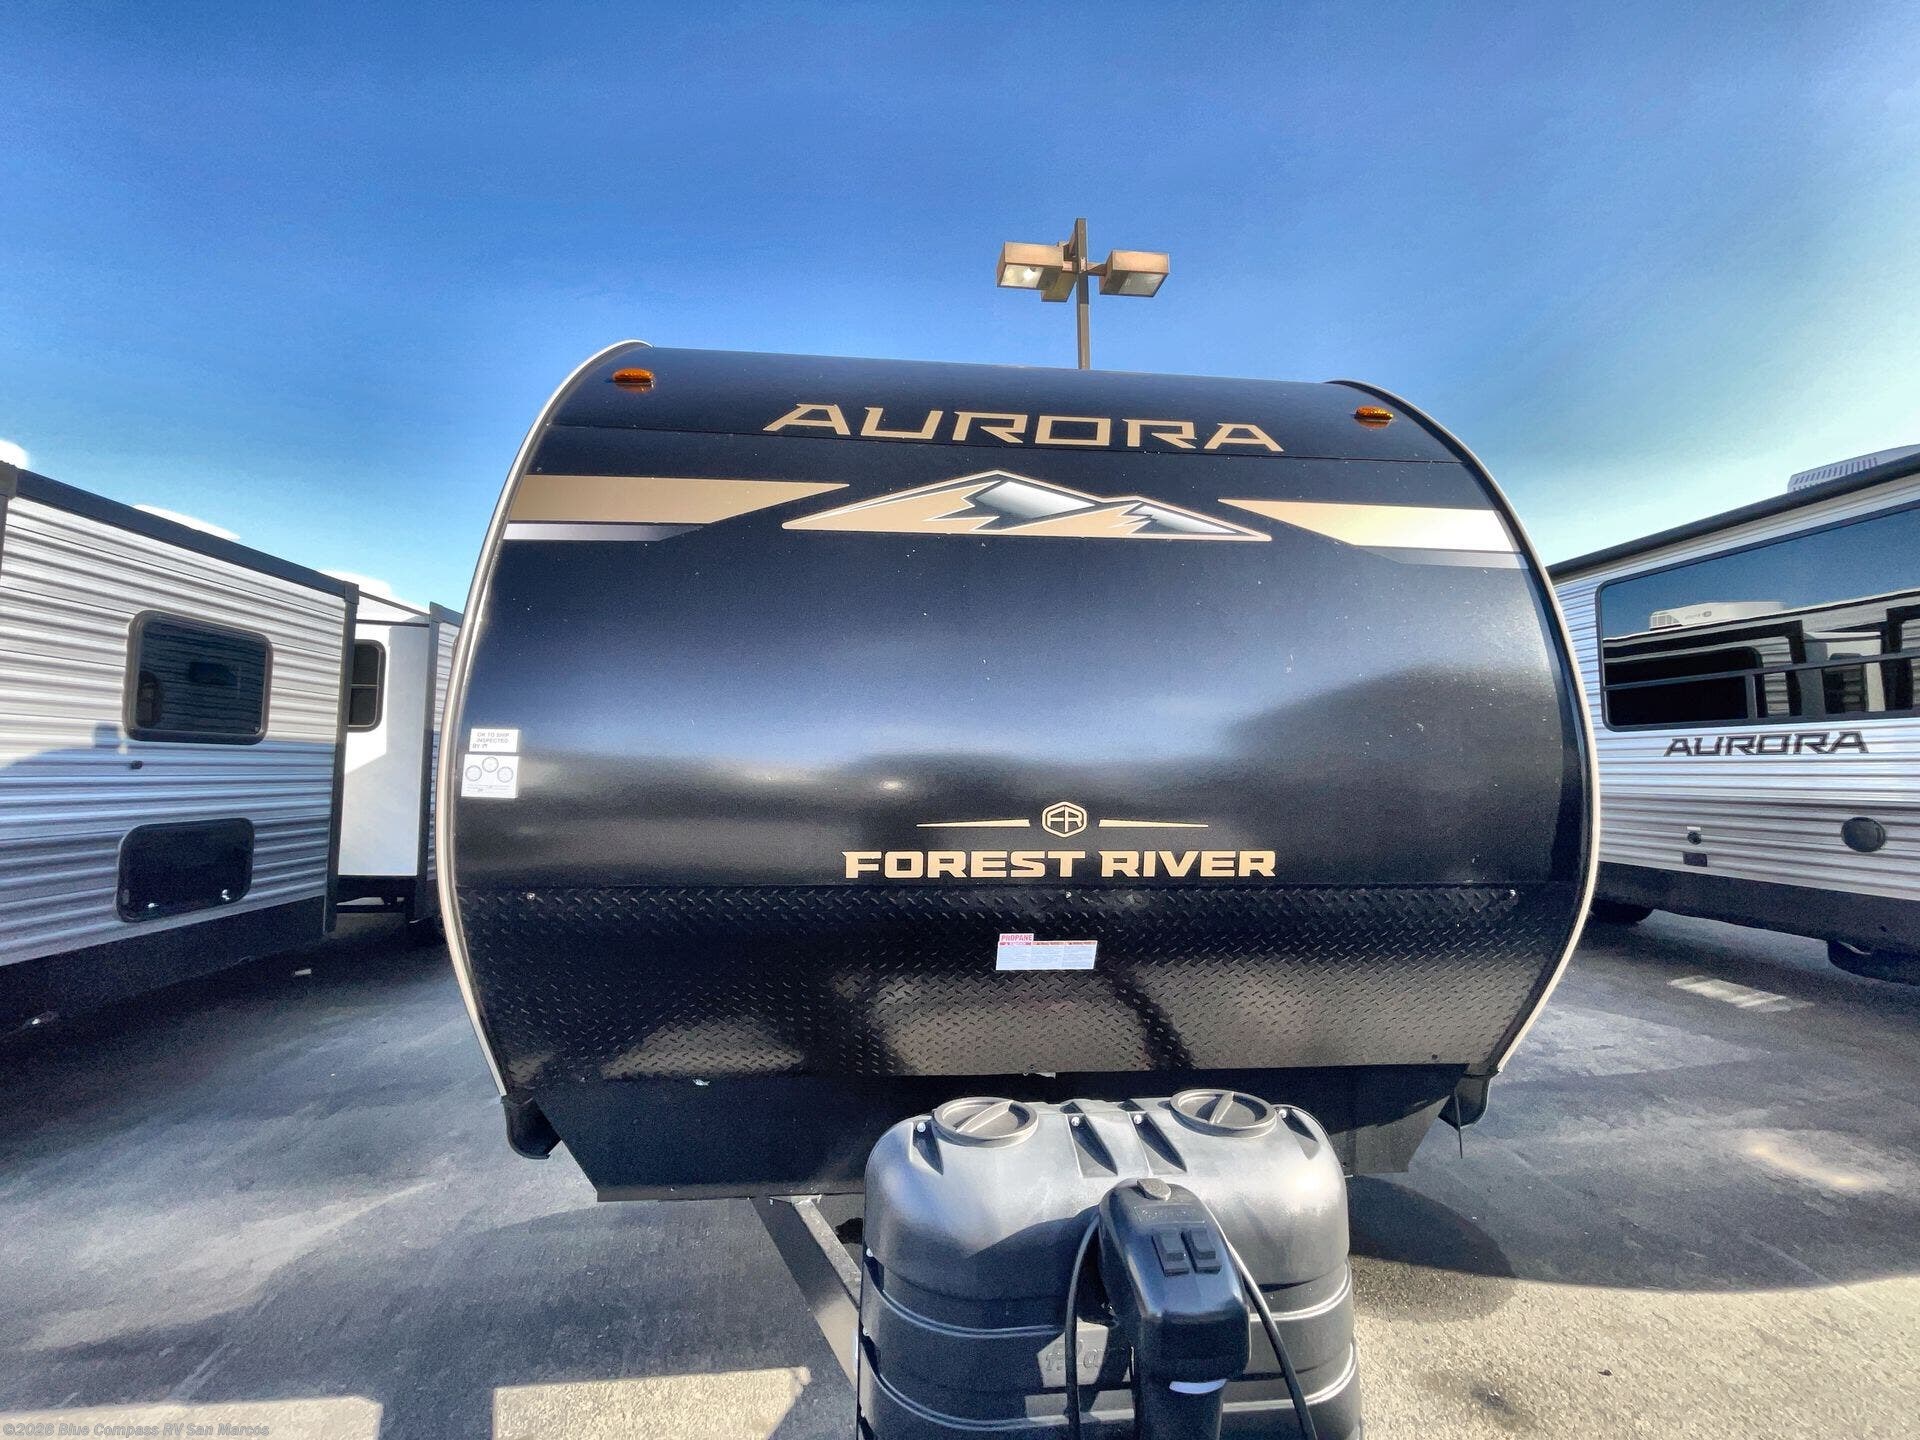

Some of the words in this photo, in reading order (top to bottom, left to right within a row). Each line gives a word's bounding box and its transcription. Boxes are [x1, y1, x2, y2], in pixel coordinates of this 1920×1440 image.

[762, 403, 1284, 452] AURORA
[1663, 730, 1869, 757] AURORA
[841, 850, 1086, 879] FOREST
[1098, 850, 1276, 879] RIVER
